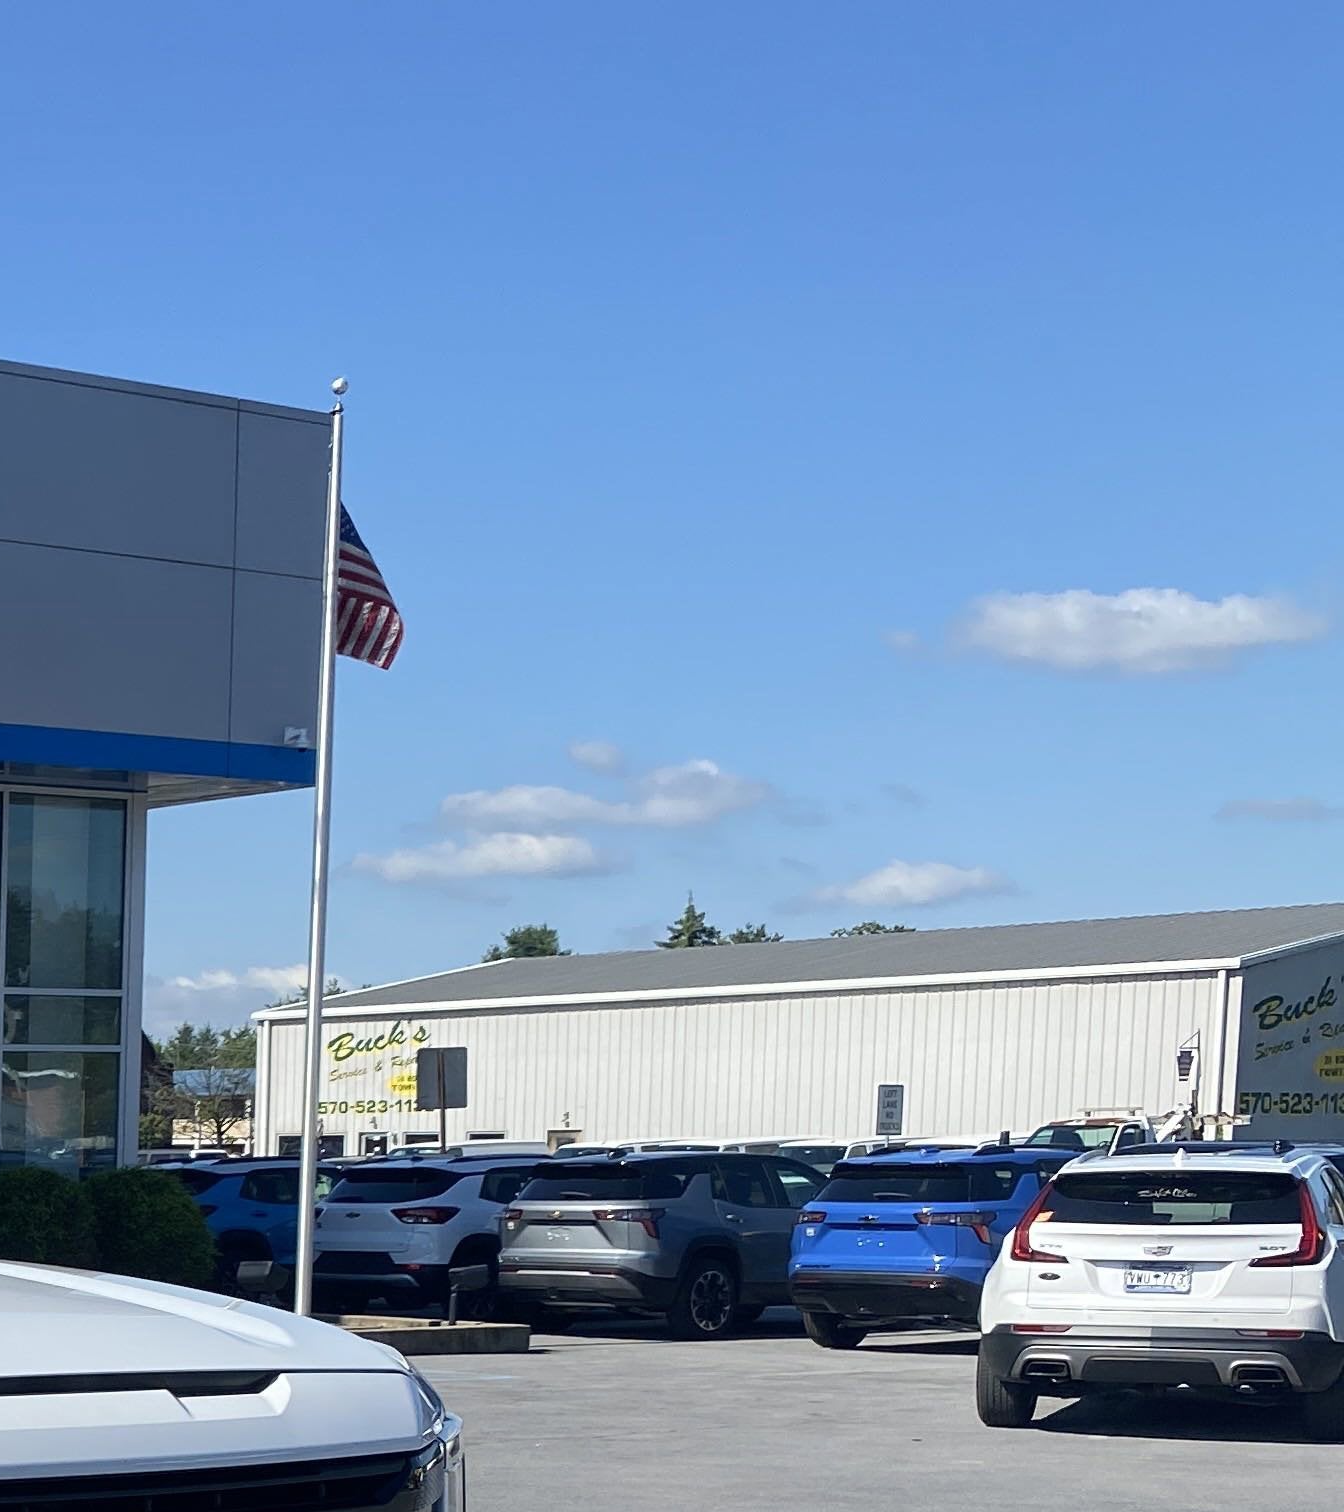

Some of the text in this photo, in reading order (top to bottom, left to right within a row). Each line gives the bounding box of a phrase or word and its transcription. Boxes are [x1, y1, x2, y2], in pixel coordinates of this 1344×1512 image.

[1252, 975, 1344, 1030] Buck'
[328, 1018, 431, 1061] Buck's
[318, 1099, 434, 1114] 570-523-11
[1239, 1092, 1344, 1115] 570-523-113
